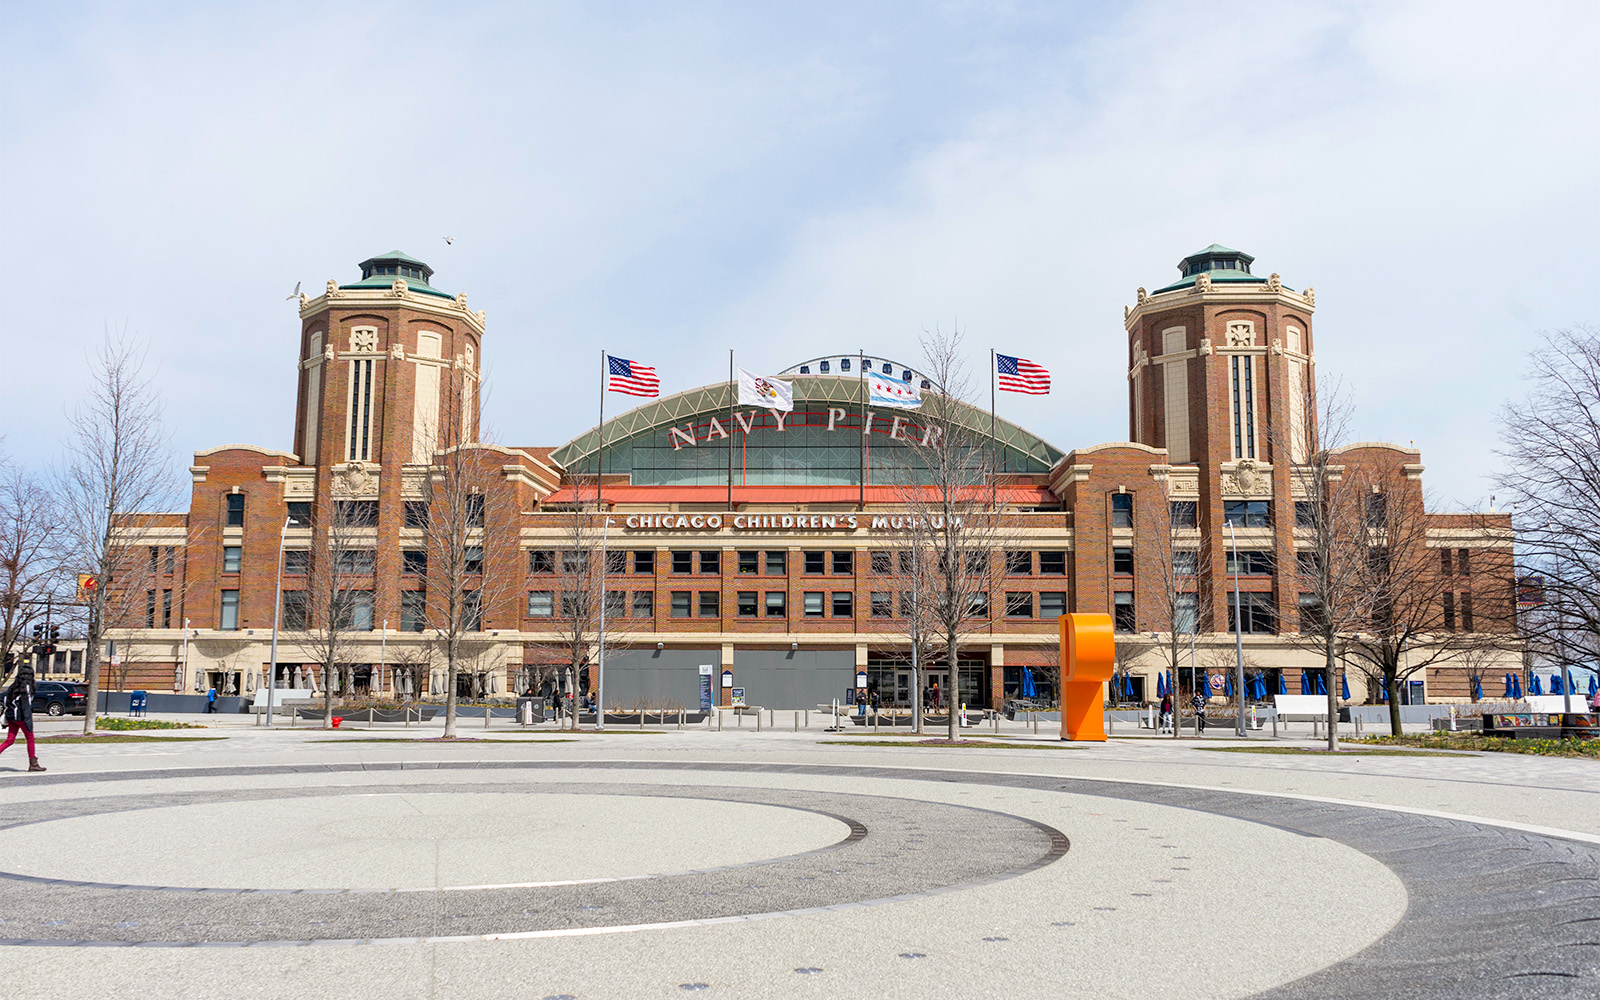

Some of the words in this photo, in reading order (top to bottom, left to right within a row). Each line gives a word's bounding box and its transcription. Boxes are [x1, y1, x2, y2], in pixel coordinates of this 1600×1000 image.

[668, 408, 788, 451] NAVY
[827, 407, 943, 449] PIER
[626, 515, 723, 529] CHICAGO
[733, 515, 858, 529] CHILDREN'S
